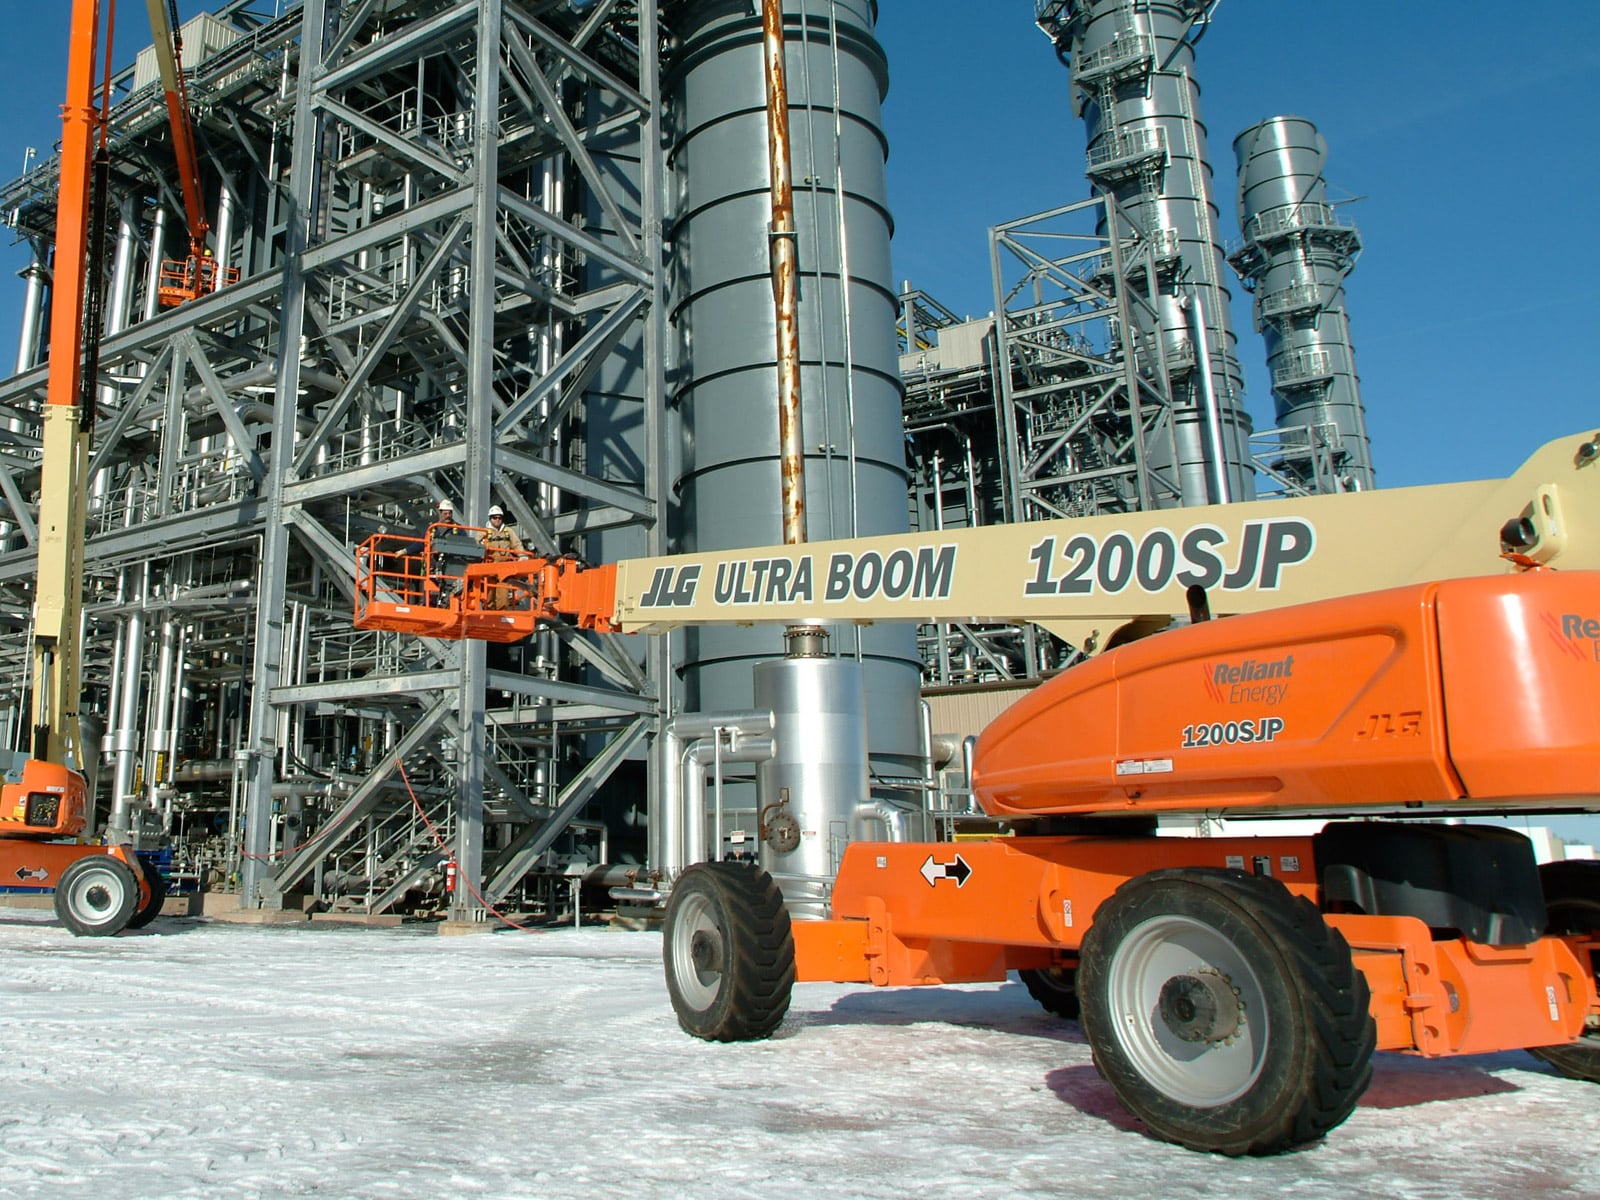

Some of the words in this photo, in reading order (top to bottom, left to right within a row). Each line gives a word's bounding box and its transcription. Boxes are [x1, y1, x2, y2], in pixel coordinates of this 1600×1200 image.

[1024, 519, 1314, 595] 1200SJP
[639, 564, 702, 608] JLG
[713, 555, 813, 606] ULTRA
[824, 544, 957, 603] BOOM
[1214, 655, 1294, 686] Reliant
[1229, 682, 1289, 706] Energy
[1182, 717, 1284, 748] 1200SJP
